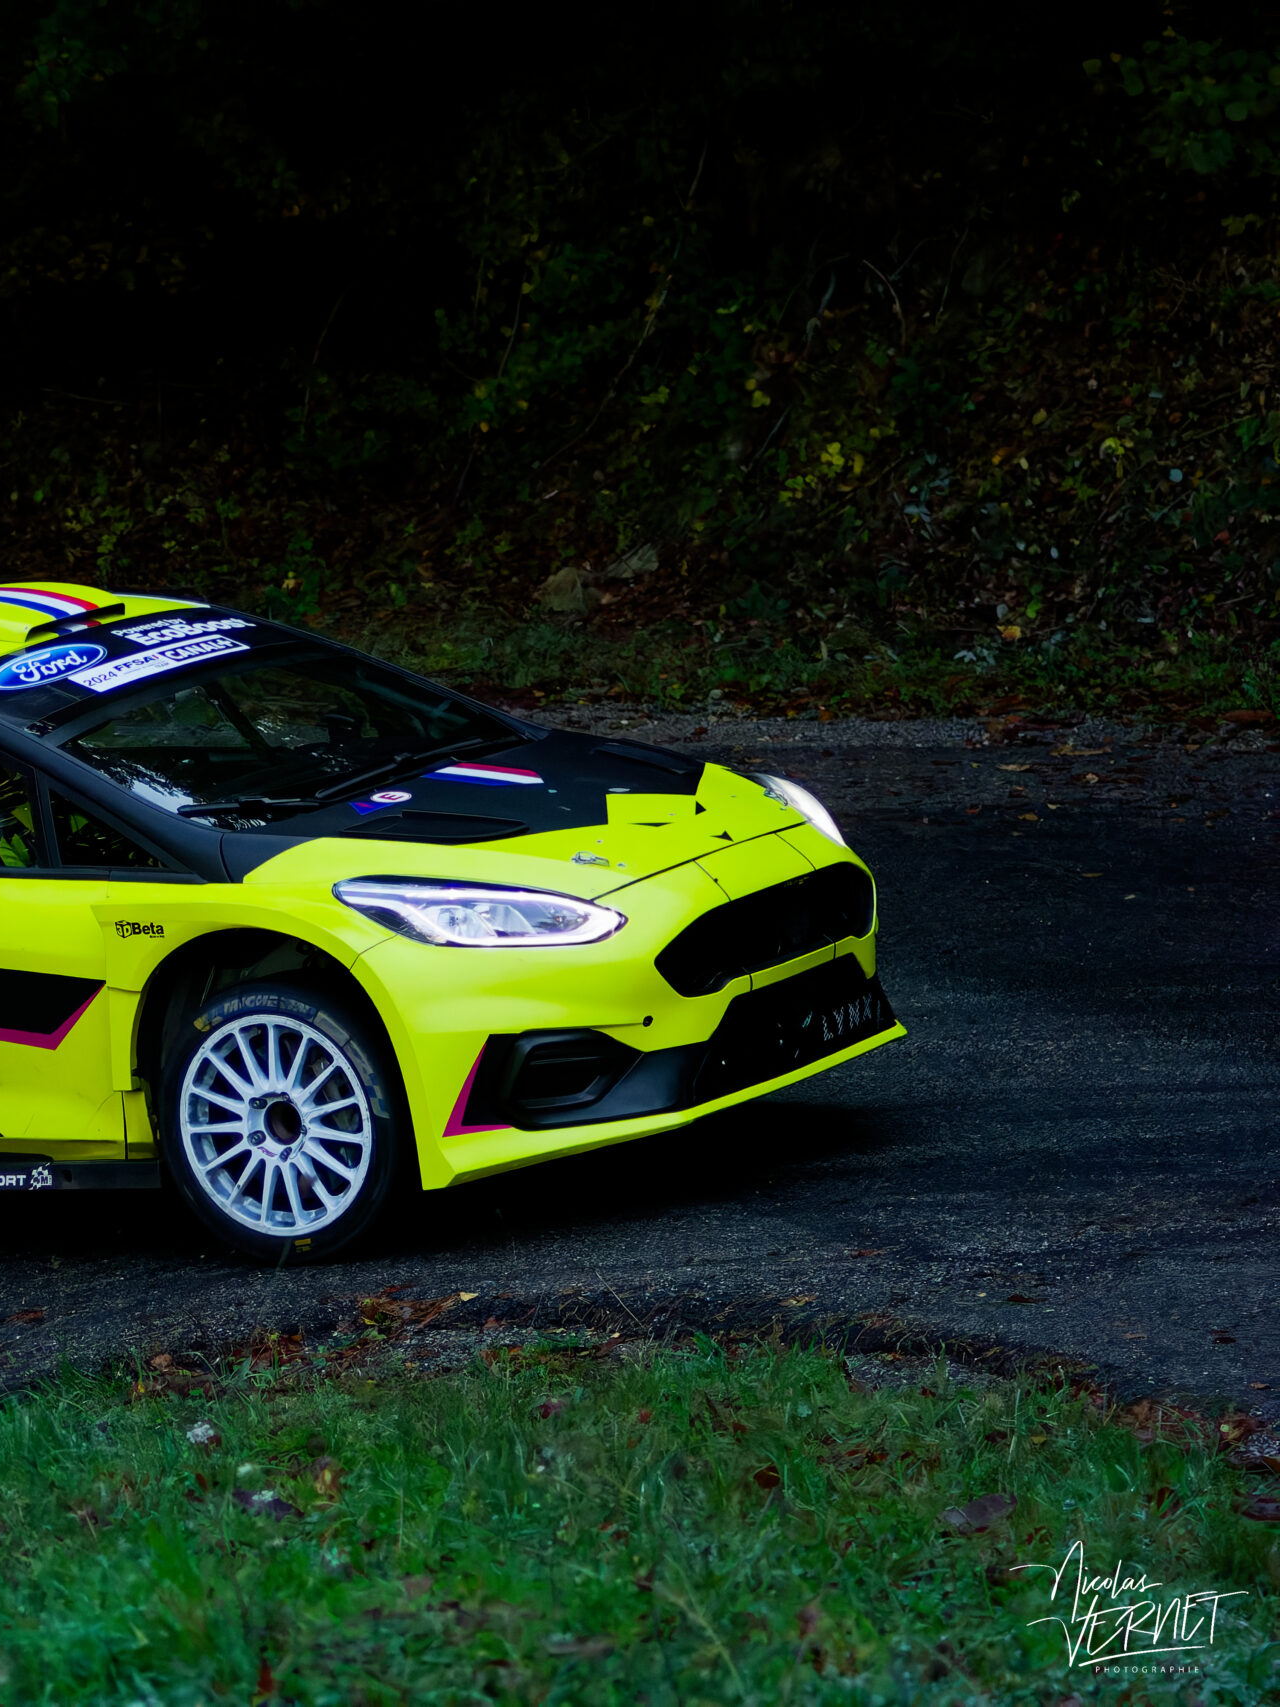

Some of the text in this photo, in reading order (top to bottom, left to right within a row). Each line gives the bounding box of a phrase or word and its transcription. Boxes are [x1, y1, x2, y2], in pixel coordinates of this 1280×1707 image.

[124, 618, 257, 646] EcoBoost
[164, 638, 234, 660] CANAL+
[11, 651, 88, 681] Ford
[83, 670, 118, 687] 2024
[113, 655, 155, 672] FFSA
